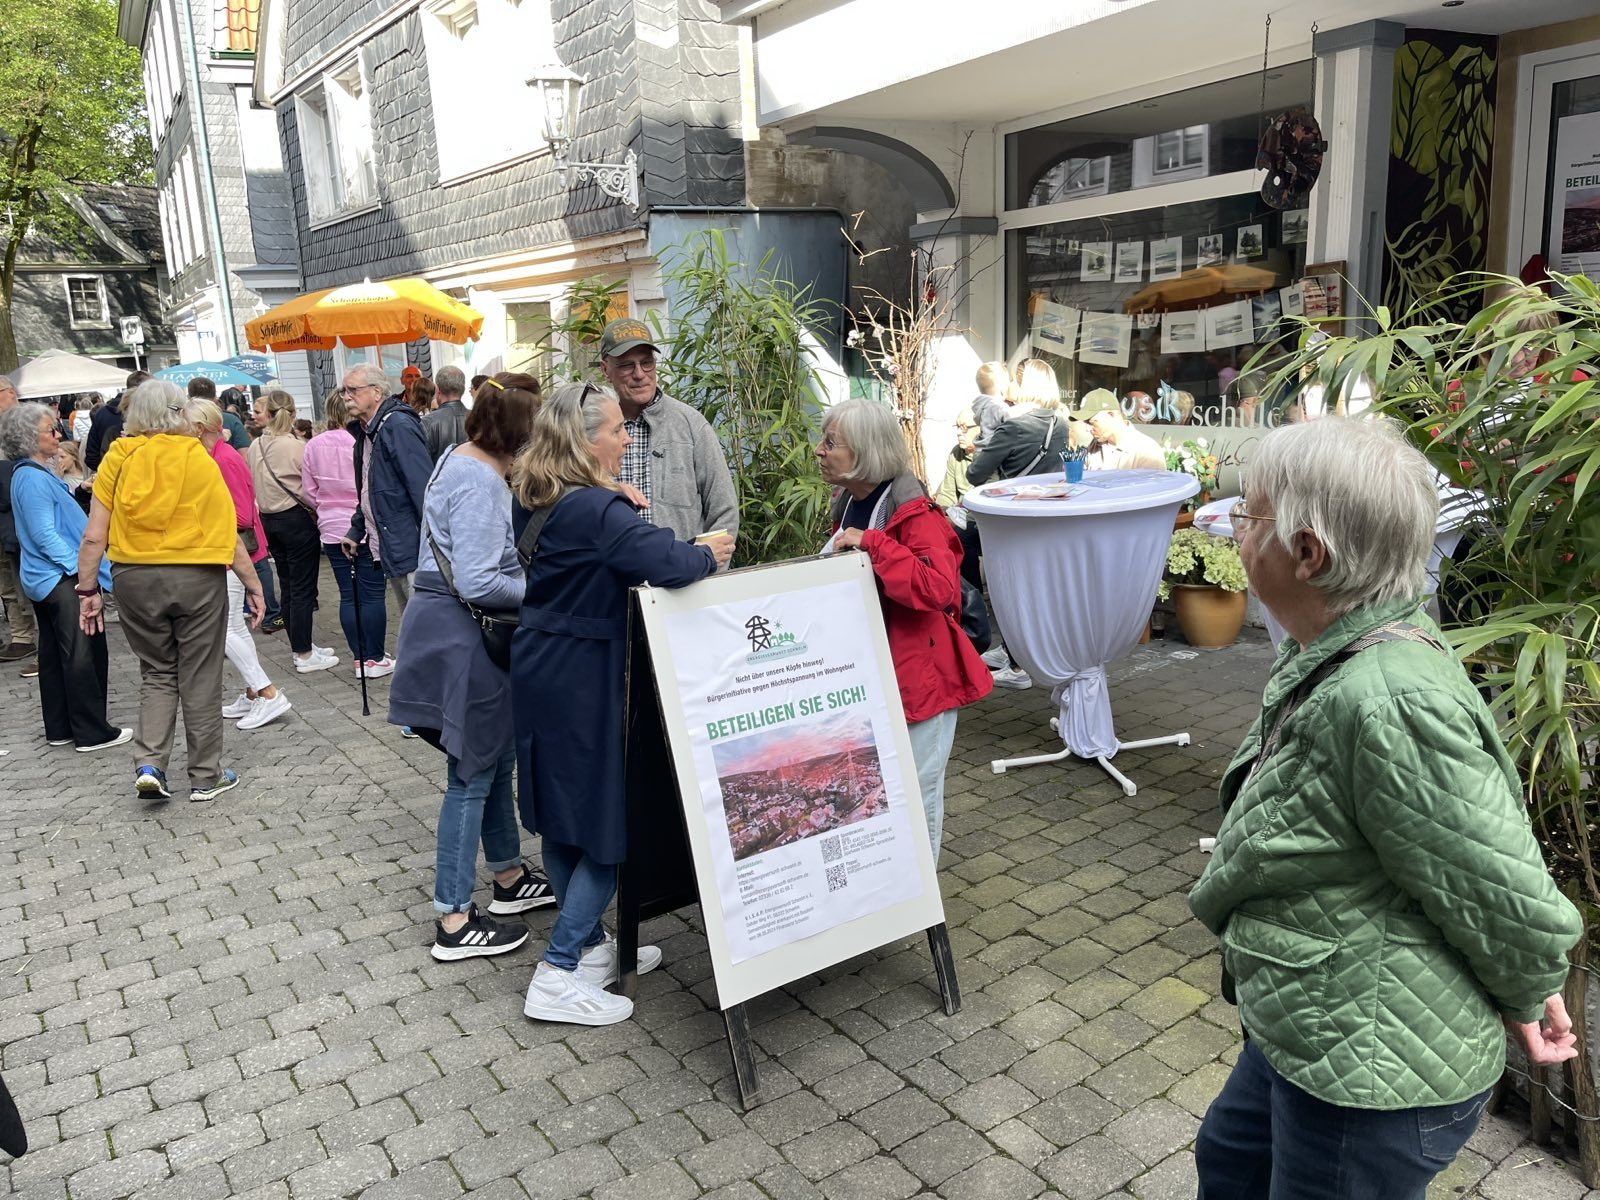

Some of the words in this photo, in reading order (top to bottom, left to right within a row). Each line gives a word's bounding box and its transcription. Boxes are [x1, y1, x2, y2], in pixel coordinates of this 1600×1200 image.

[1566, 174, 1600, 188] BETEIL
[423, 314, 457, 336] Schöfferhofer
[163, 371, 229, 380] HAANER
[707, 686, 752, 703] Bürgerinitiative
[752, 683, 770, 694] gegen
[770, 673, 816, 689] Höchstspannung
[824, 662, 855, 676] Wohngebiet
[735, 674, 751, 684] Nicht
[752, 671, 765, 681] über
[766, 667, 785, 678] unsere
[786, 662, 802, 674] Köpfe
[803, 658, 825, 669] hinweg!
[706, 703, 796, 740] BETEILIGEN
[799, 695, 824, 717] SIE
[827, 685, 867, 709] SICH!
